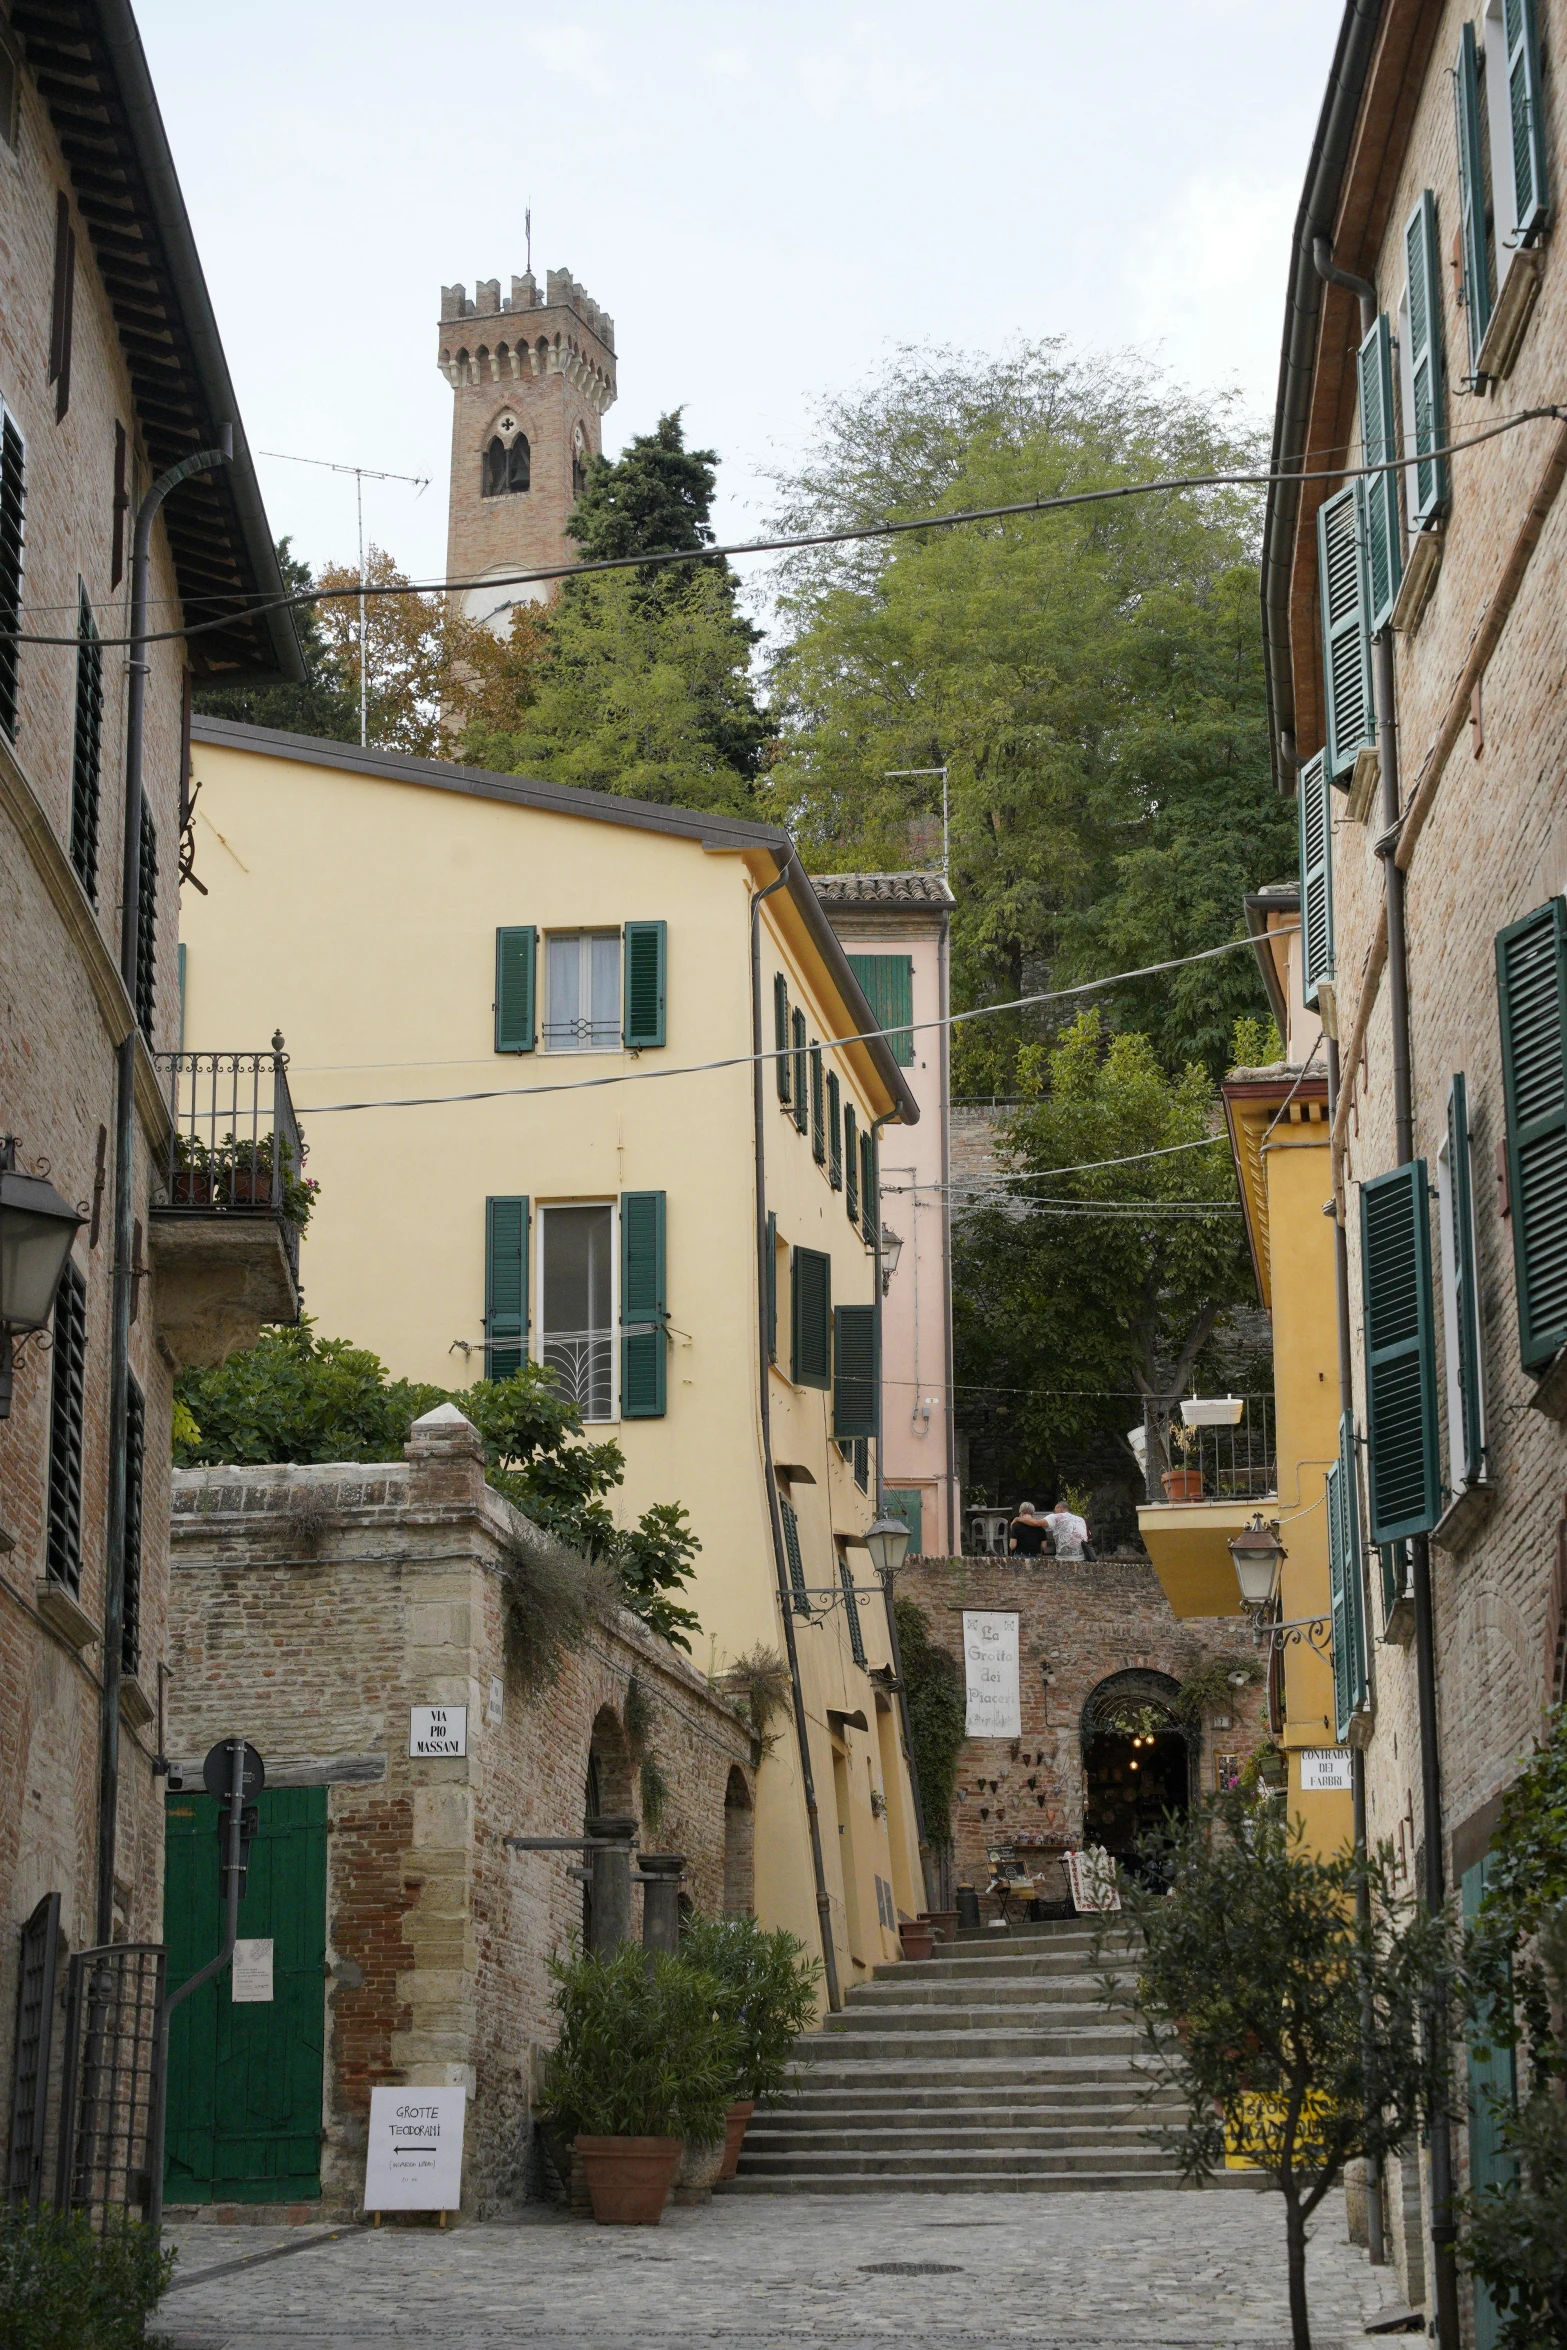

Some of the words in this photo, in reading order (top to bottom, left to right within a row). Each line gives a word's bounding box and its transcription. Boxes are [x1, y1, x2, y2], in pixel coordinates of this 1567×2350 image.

[982, 1625, 999, 1641] La
[968, 1645, 1013, 1661] Grotta
[980, 1667, 1001, 1682] dei
[968, 1687, 1015, 1704] Piaceri
[430, 1710, 447, 1722] VIA
[430, 1725, 447, 1737] PIO
[416, 1740, 459, 1753] MASSANI
[1301, 1750, 1350, 1760] CONTRADA
[1319, 1762, 1334, 1773] DEI
[1310, 1775, 1343, 1786] FABBRI
[396, 2105, 440, 2119] GROTTE
